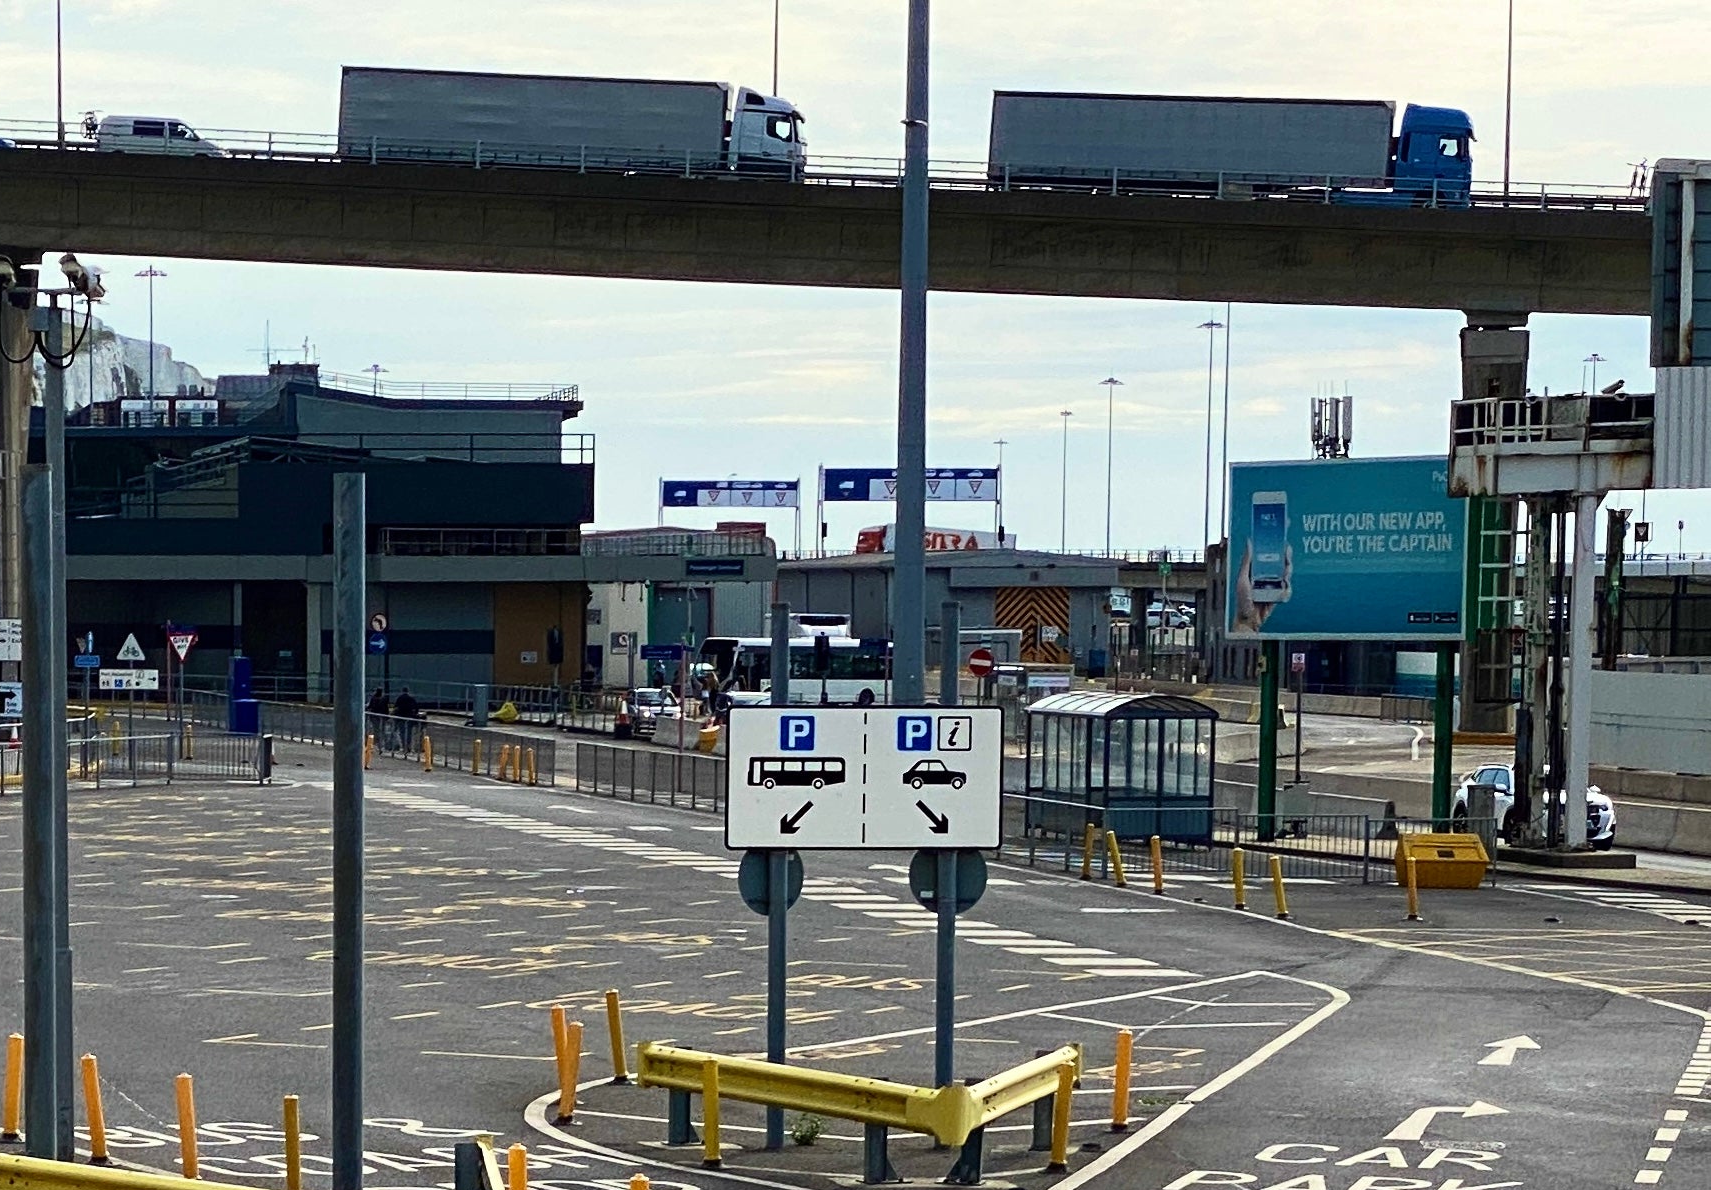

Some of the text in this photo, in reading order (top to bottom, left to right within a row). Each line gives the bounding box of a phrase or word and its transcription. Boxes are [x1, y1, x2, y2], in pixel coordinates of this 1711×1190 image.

[1302, 511, 1447, 532] WITH OUR NEW APP,
[1301, 533, 1453, 554] YOU'RE THE CAPTAIN
[174, 1144, 644, 1179] COACH
[1254, 1143, 1503, 1172] CAR
